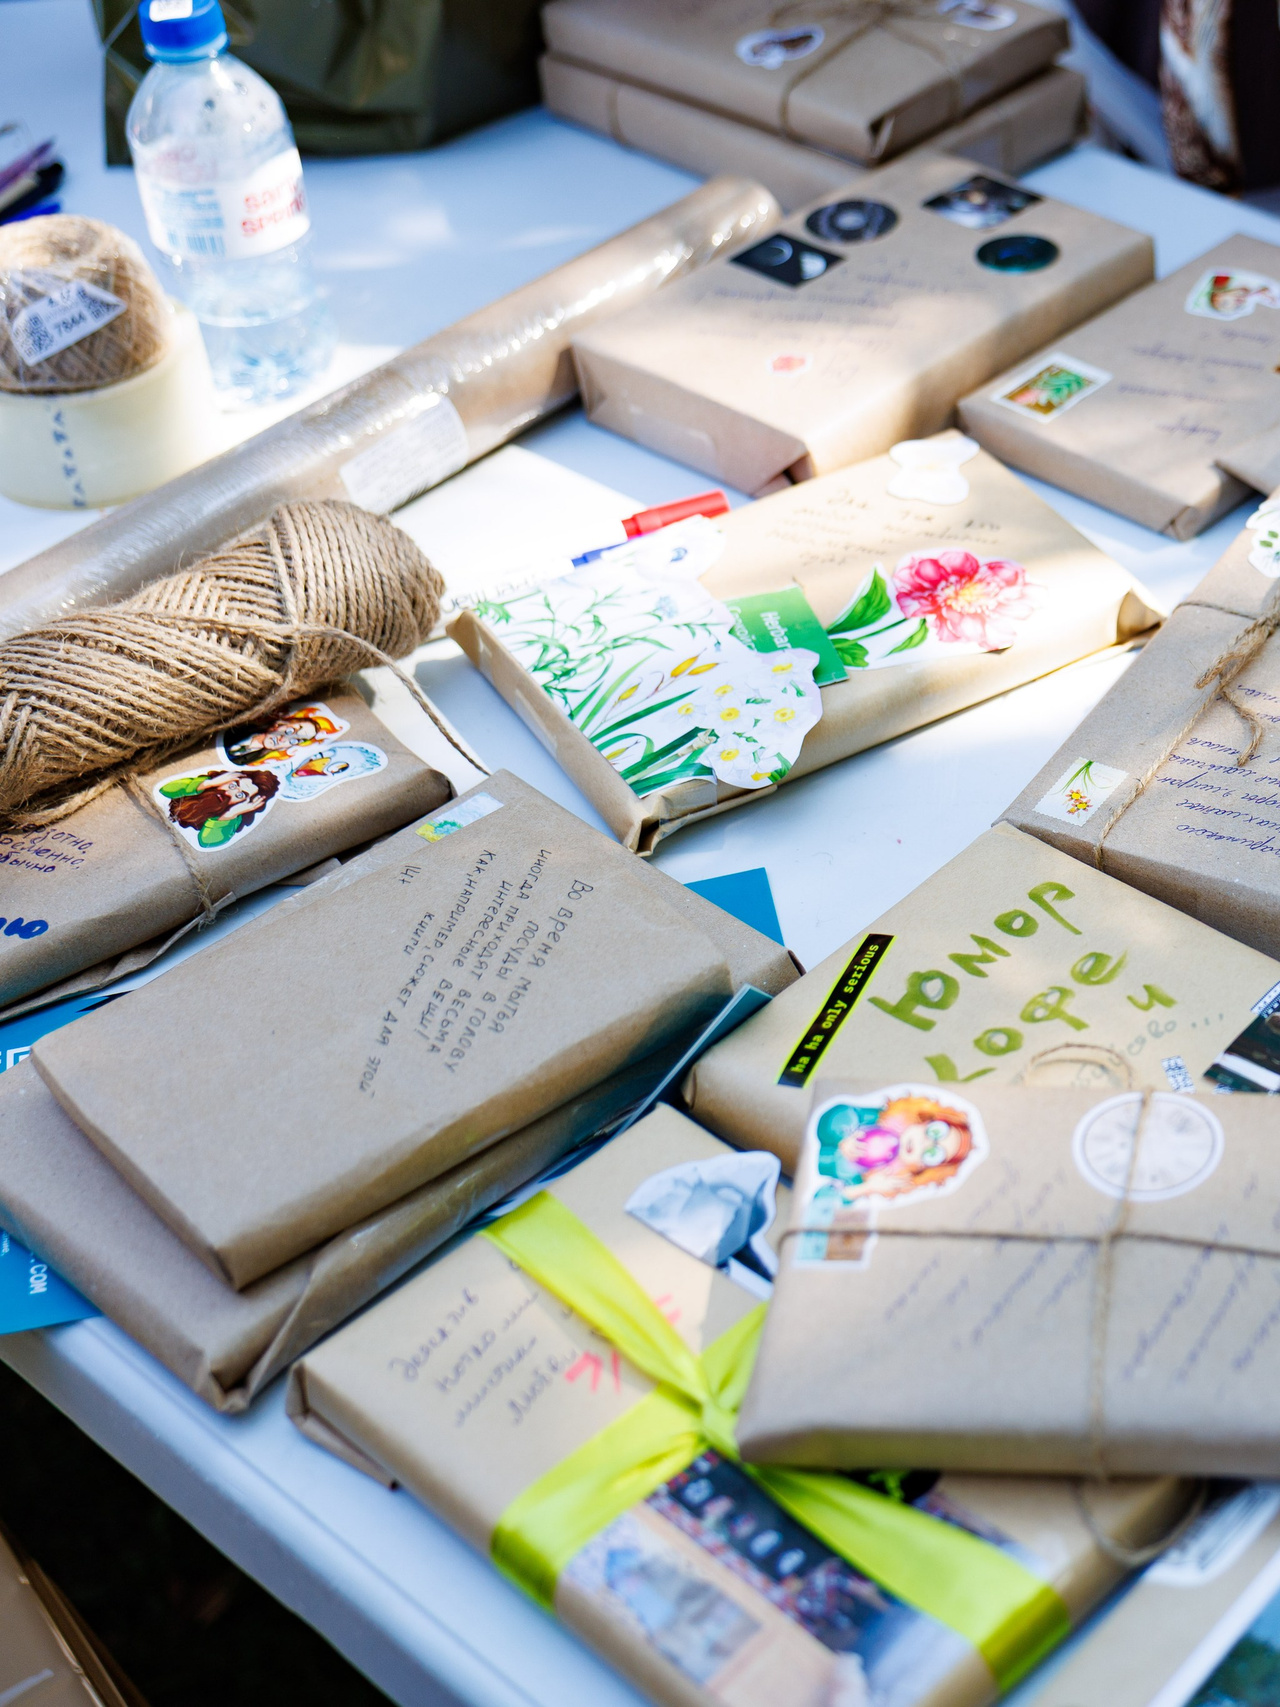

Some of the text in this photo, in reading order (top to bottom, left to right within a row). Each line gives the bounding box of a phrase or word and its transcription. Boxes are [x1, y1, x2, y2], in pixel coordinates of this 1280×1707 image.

[1186, 737, 1262, 764] пнимать
[791, 944, 879, 1073] ha ha only serious
[29, 1251, 49, 1296] .COM
